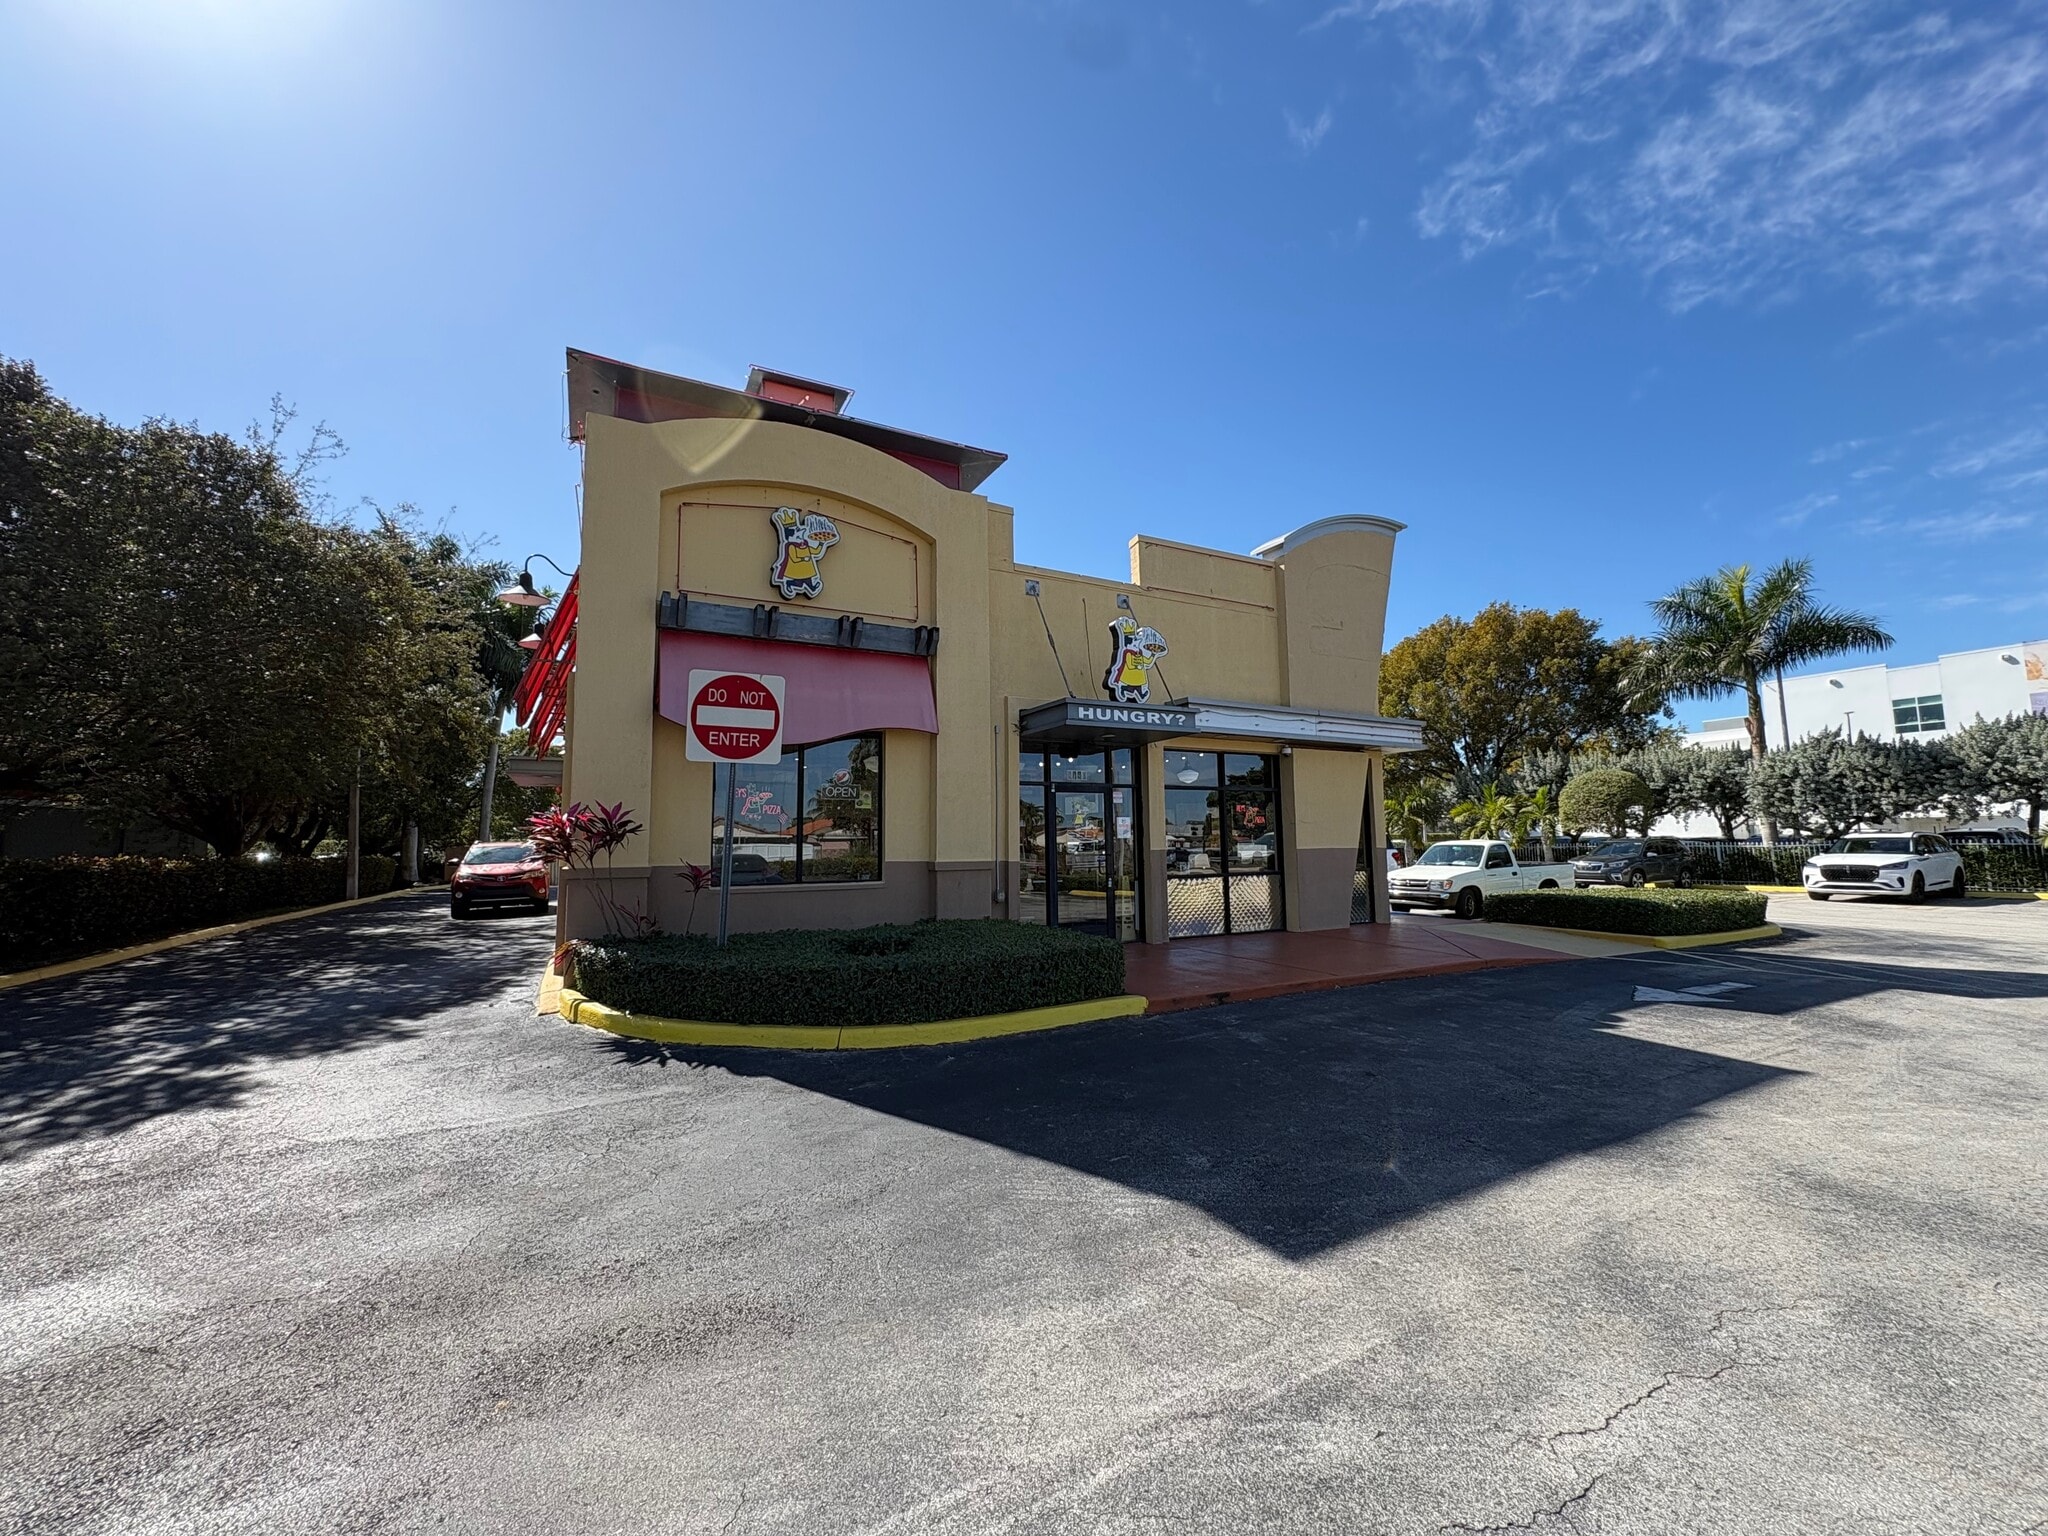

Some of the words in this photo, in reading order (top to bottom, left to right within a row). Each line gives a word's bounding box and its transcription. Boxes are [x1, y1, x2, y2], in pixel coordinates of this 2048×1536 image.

[708, 688, 727, 702] DO
[740, 691, 766, 705] NOT
[1078, 706, 1186, 726] HUNGRY?
[709, 732, 760, 747] ENTER
[736, 788, 747, 797] EY'S
[826, 787, 857, 797] OPEN
[762, 805, 781, 814] PIZZA
